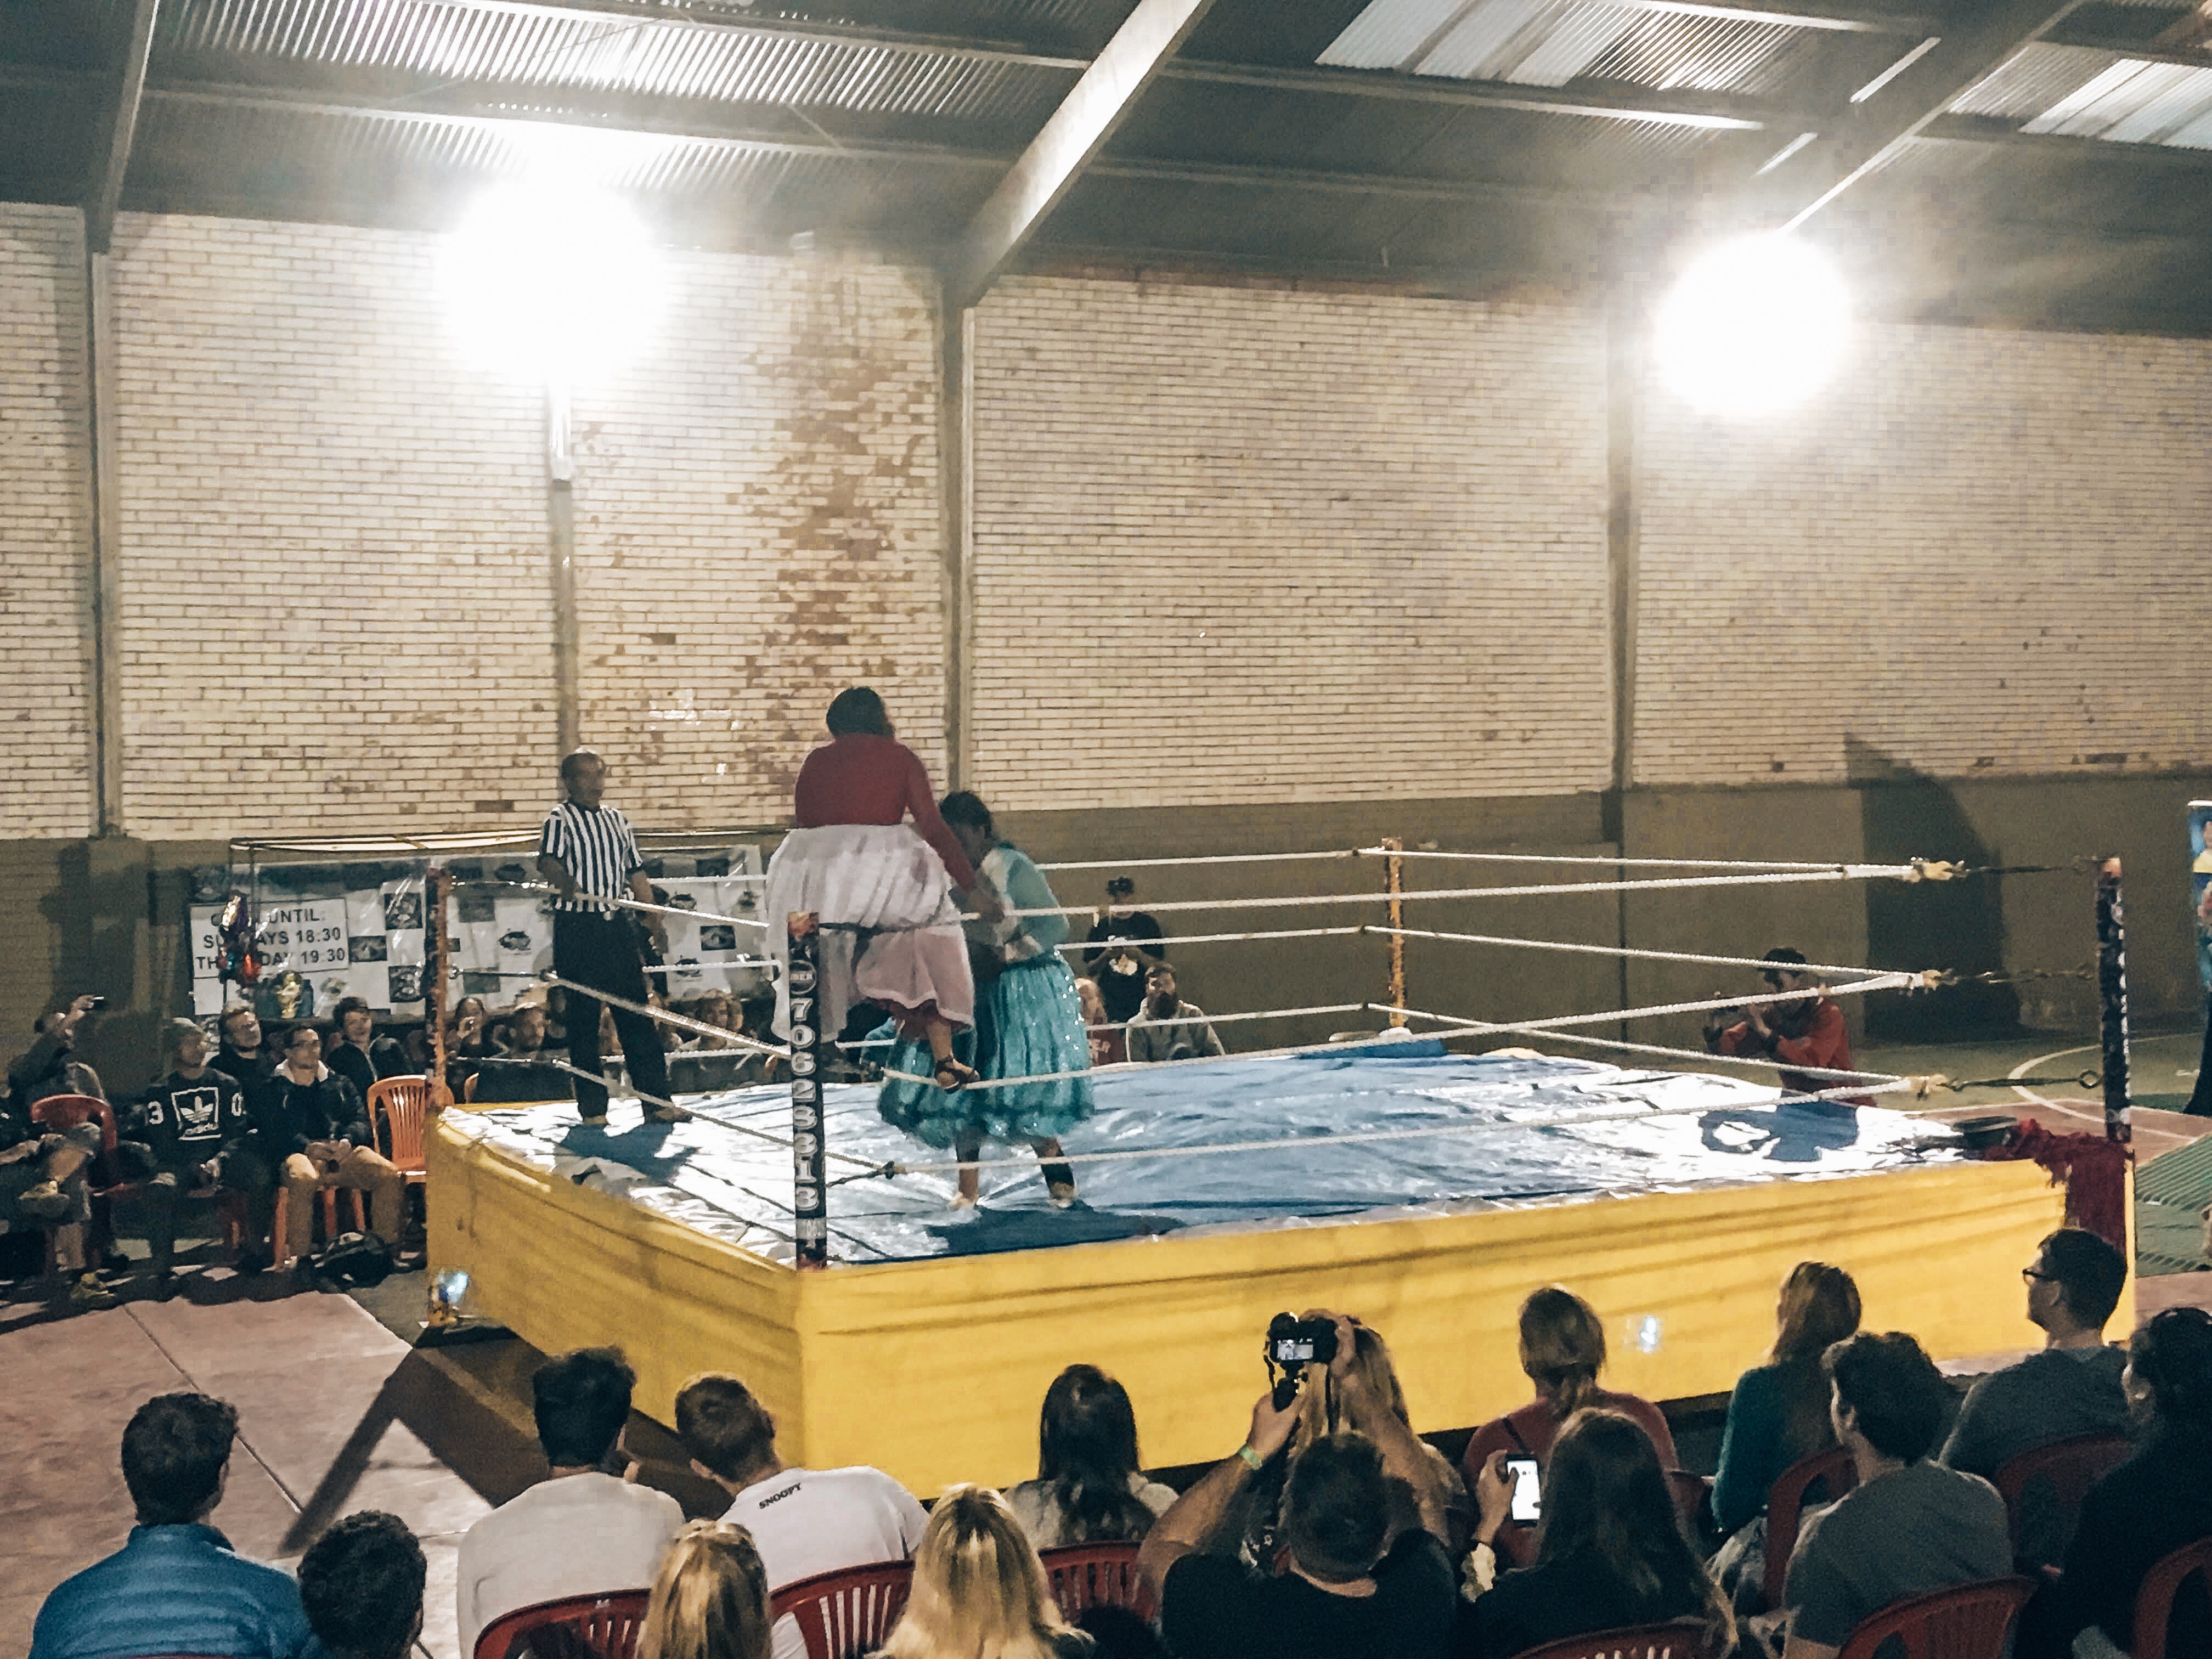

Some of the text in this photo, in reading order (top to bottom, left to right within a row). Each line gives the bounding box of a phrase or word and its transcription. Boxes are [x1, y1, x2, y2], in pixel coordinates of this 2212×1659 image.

[204, 927, 341, 949] SUAYS 18.30
[148, 1101, 164, 1124] 3
[759, 1482, 802, 1509] SNOOPY
